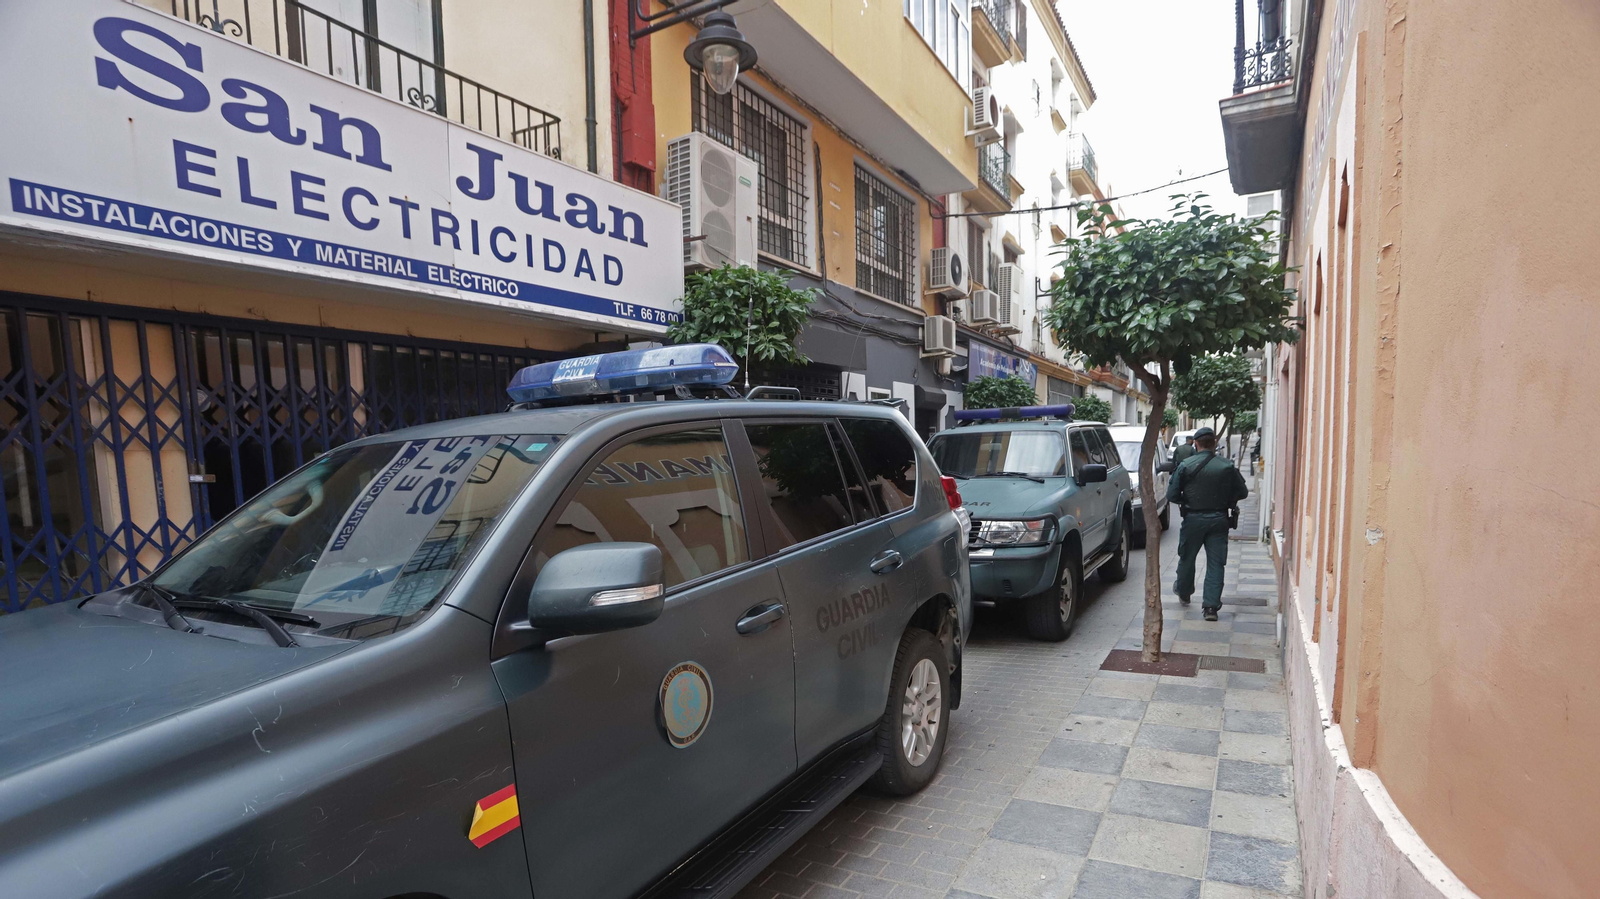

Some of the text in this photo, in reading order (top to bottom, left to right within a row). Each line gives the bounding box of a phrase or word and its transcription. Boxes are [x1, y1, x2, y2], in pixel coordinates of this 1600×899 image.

[93, 15, 648, 248] San Juan
[23, 185, 274, 252] INSTALACIONES
[287, 238, 302, 257] Y
[315, 243, 418, 278] MATERIAL
[173, 138, 624, 286] ELECTRICIDAD
[613, 301, 636, 317] TLF.
[641, 308, 653, 321] 66
[655, 310, 666, 323] 78
[559, 356, 600, 370] GUARDIA
[564, 367, 585, 379] CIVIL
[816, 582, 891, 634] GUARDIA
[838, 621, 880, 660] CIVIL
[663, 664, 701, 691] GUARDIA CIVIL
